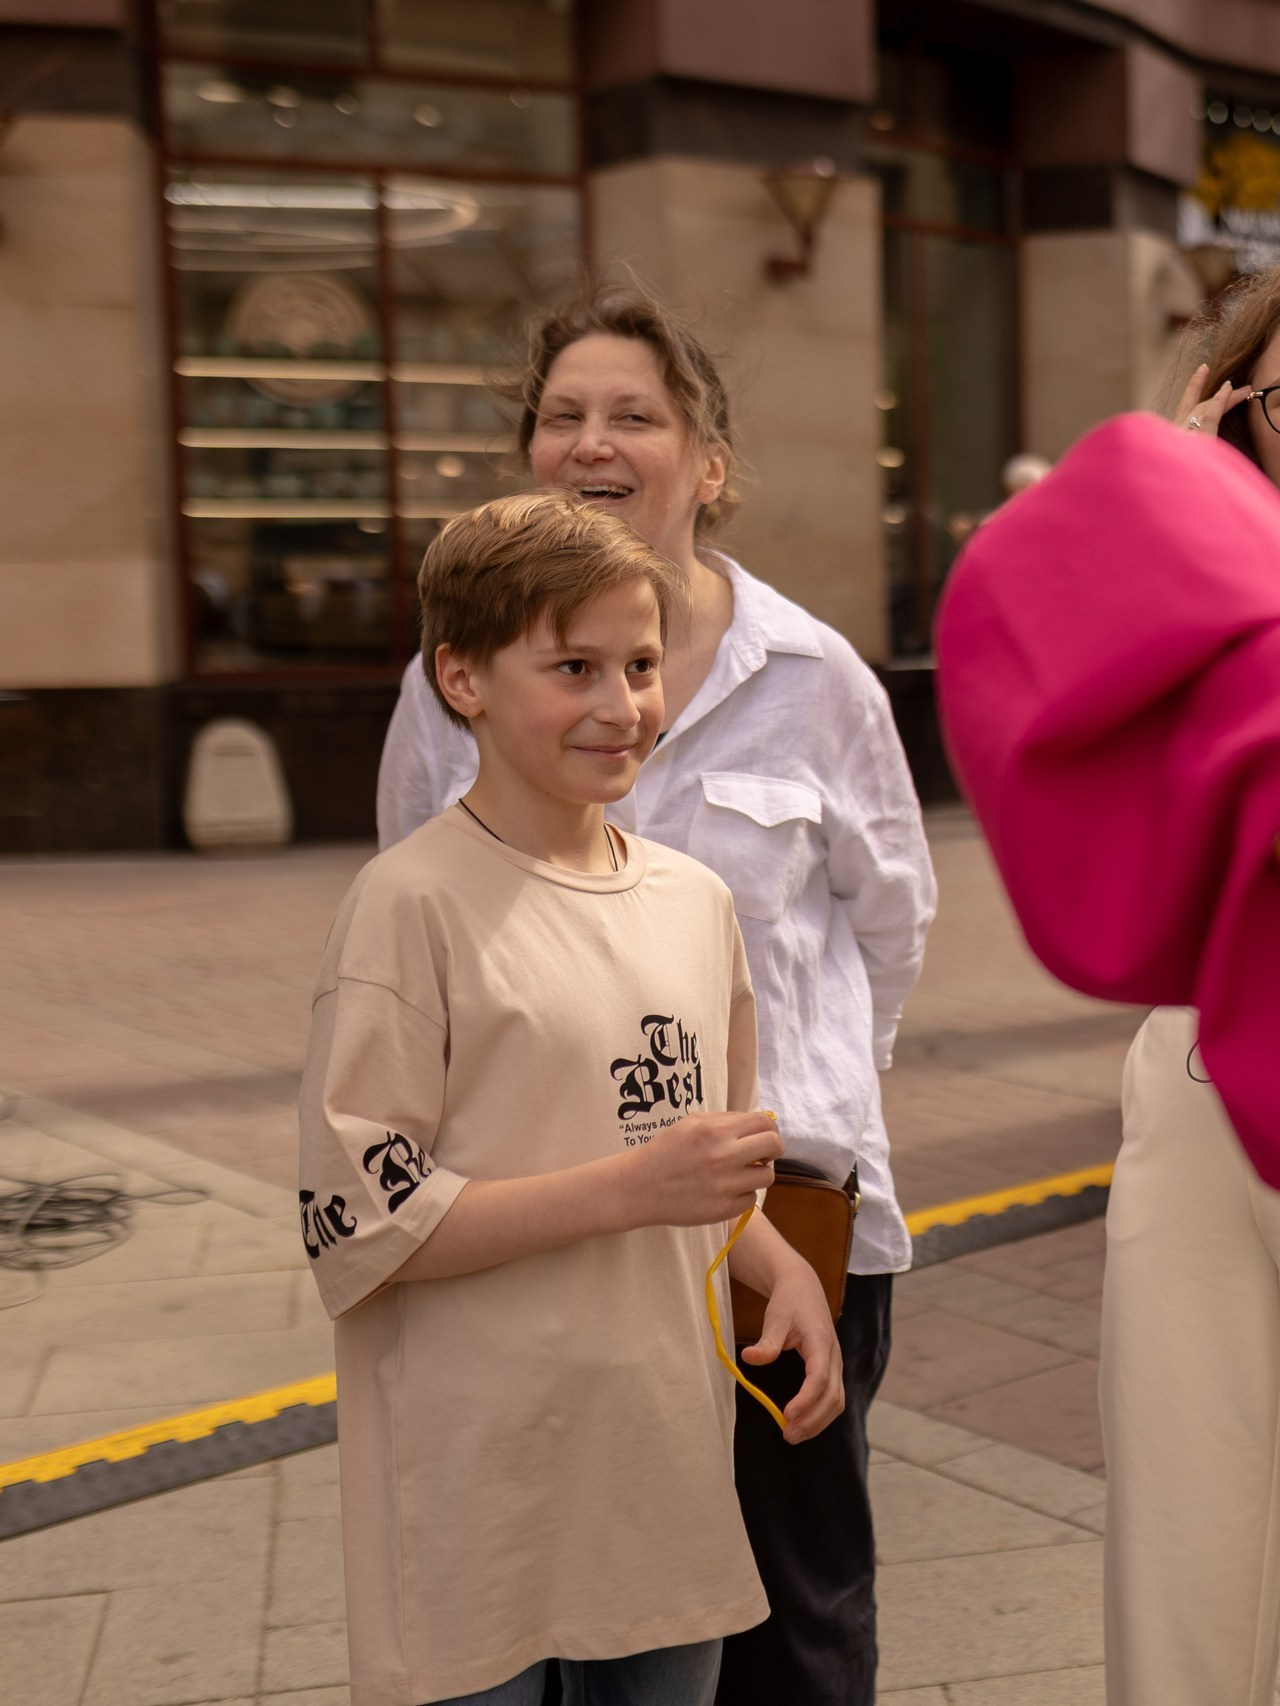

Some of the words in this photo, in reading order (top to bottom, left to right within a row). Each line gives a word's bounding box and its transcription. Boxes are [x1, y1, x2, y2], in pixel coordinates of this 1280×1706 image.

[641, 1014, 698, 1066] The
[610, 1054, 704, 1120] Best
[624, 1138, 636, 1147] To
